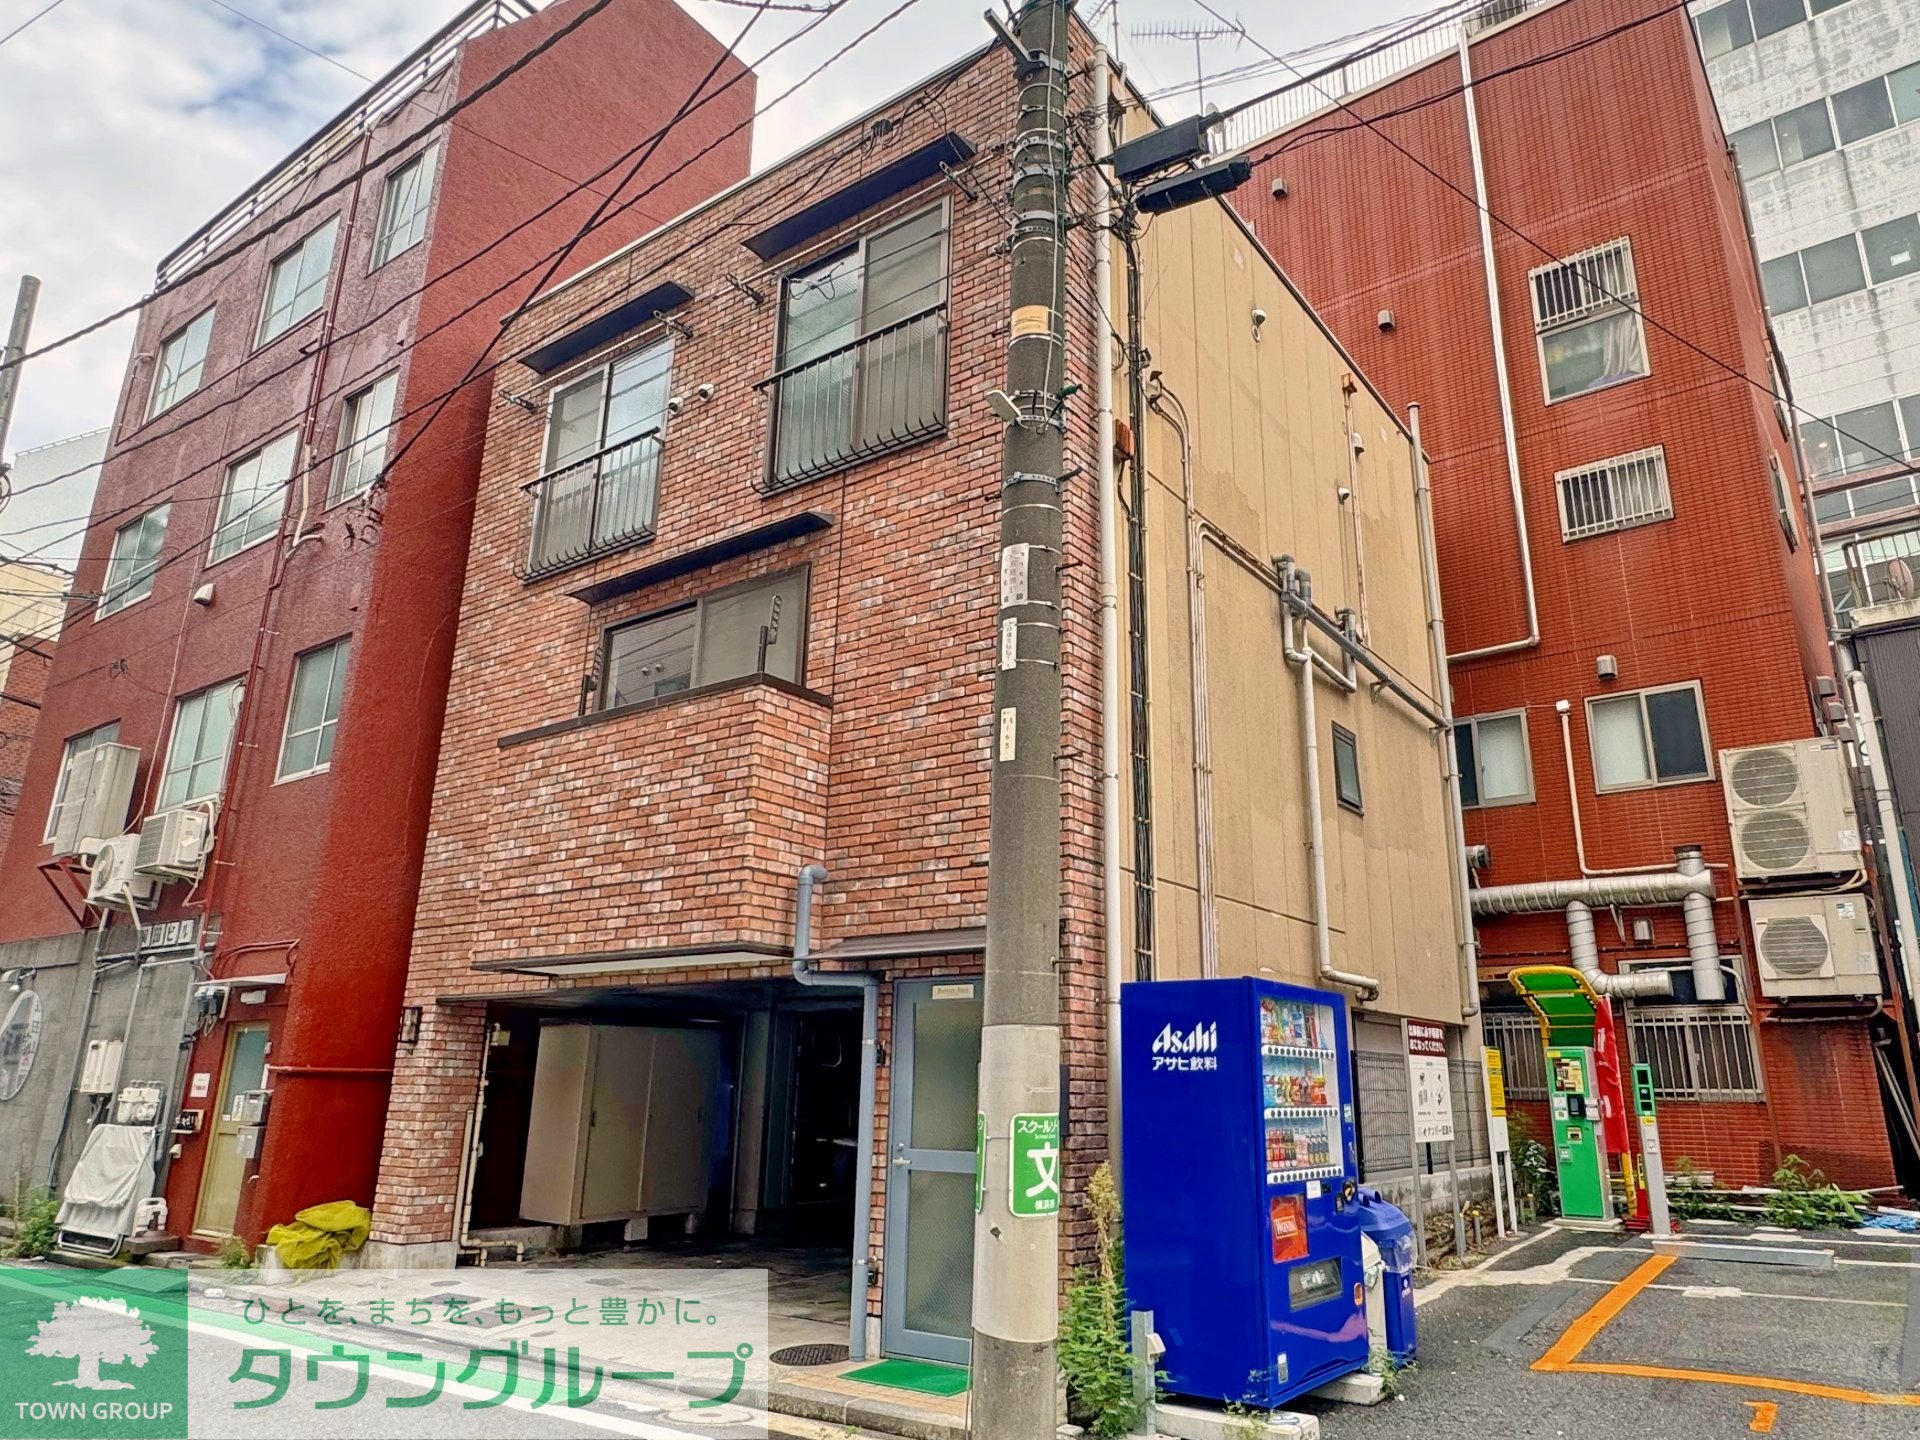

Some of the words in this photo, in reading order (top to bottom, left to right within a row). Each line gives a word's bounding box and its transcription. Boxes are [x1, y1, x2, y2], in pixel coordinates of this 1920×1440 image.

[1151, 1021, 1218, 1053] Asahi
[1151, 1055, 1217, 1071] アサヒ飲料
[1025, 1141, 1058, 1198] 文
